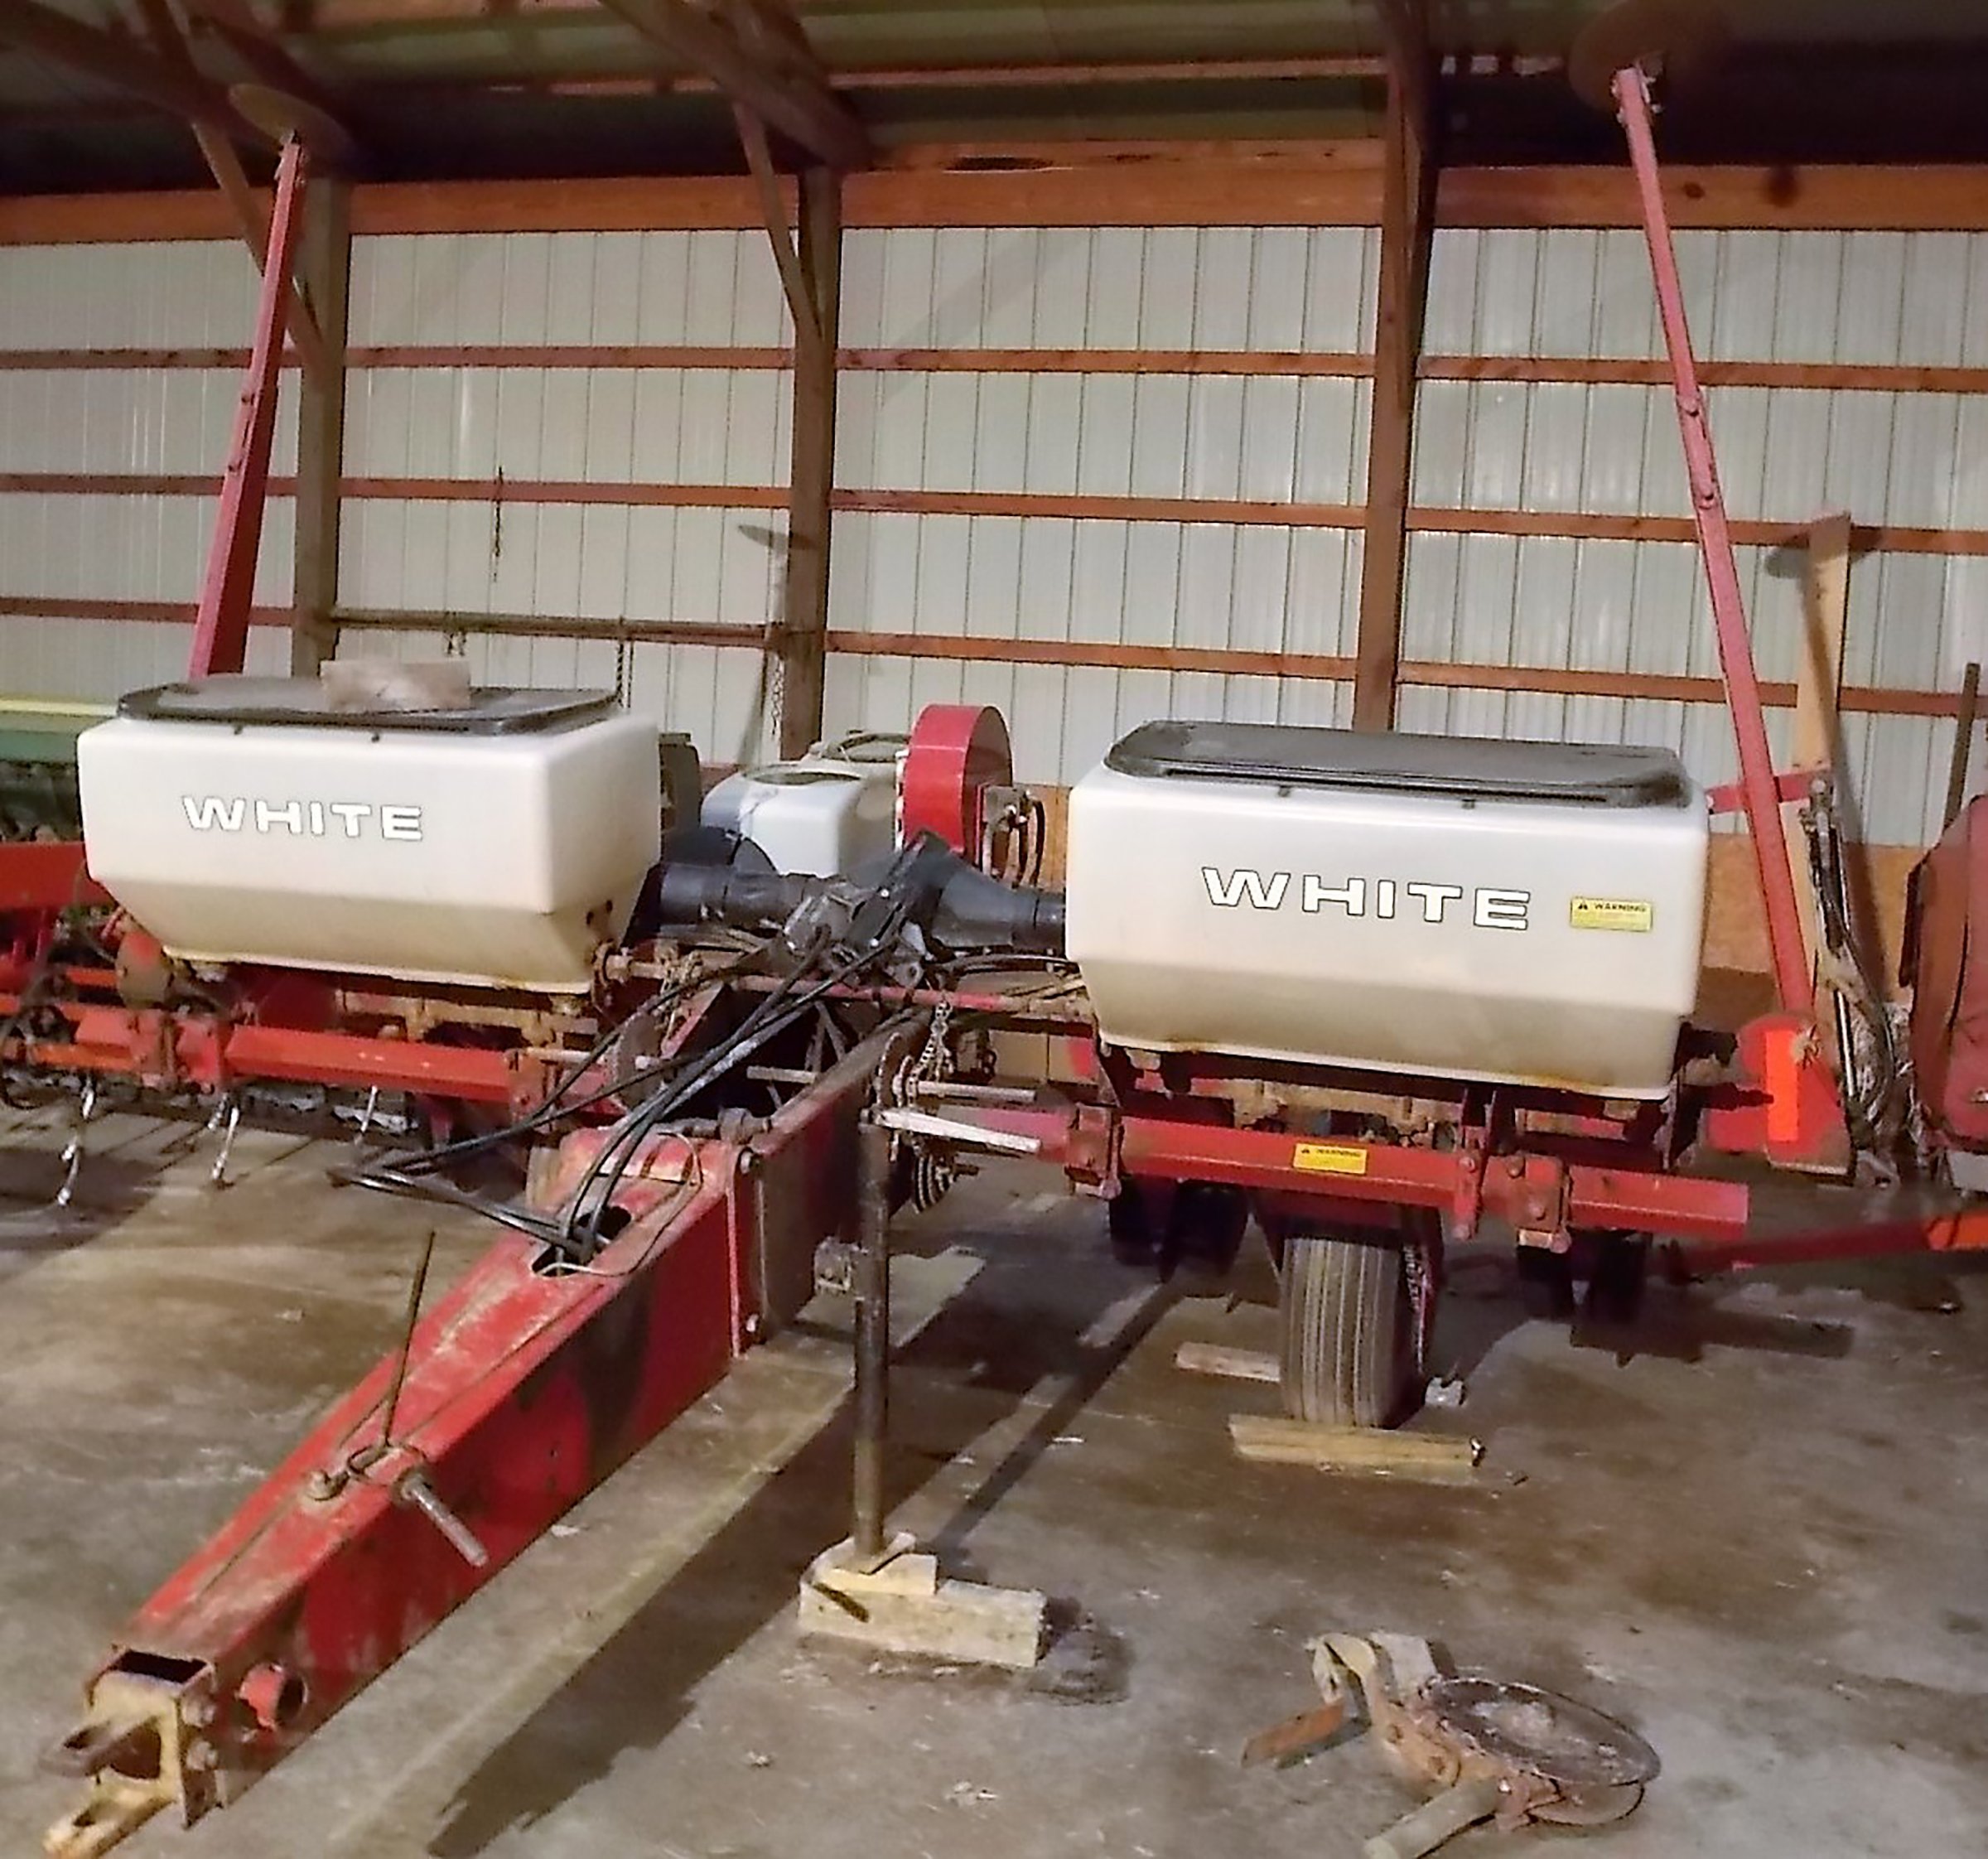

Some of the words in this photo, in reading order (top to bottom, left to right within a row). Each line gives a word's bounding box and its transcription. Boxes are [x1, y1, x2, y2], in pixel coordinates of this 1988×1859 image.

[181, 795, 423, 841] WHITE
[1201, 867, 1531, 930] WHITE
[1594, 902, 1647, 912] WARNING
